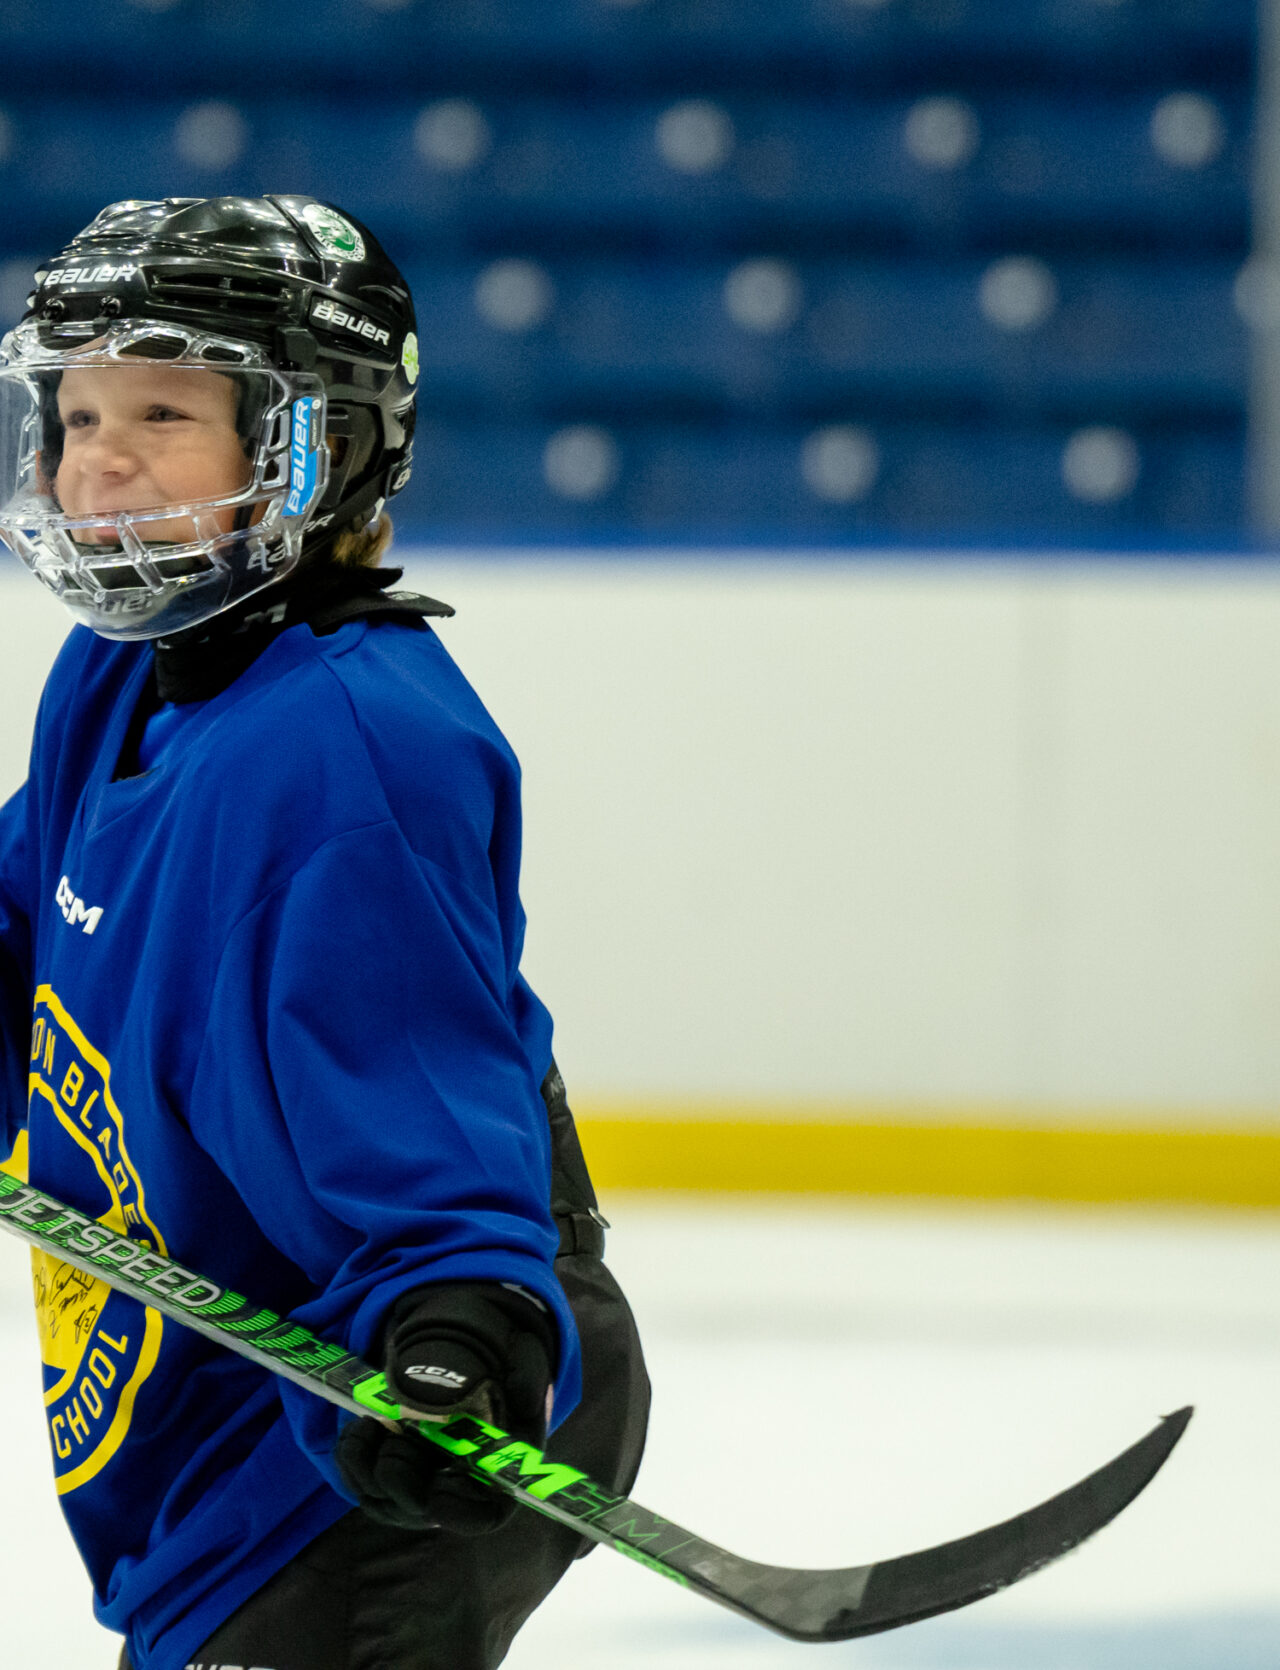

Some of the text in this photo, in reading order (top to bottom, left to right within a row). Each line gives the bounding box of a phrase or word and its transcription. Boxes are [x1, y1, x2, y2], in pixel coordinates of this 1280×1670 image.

[44, 265, 138, 286] BAUER
[312, 304, 391, 346] BAUER
[287, 400, 310, 513] BAUER
[60, 1060, 152, 1251] BLADE
[51, 1329, 129, 1460] CHOOL
[404, 1364, 467, 1385] CCM
